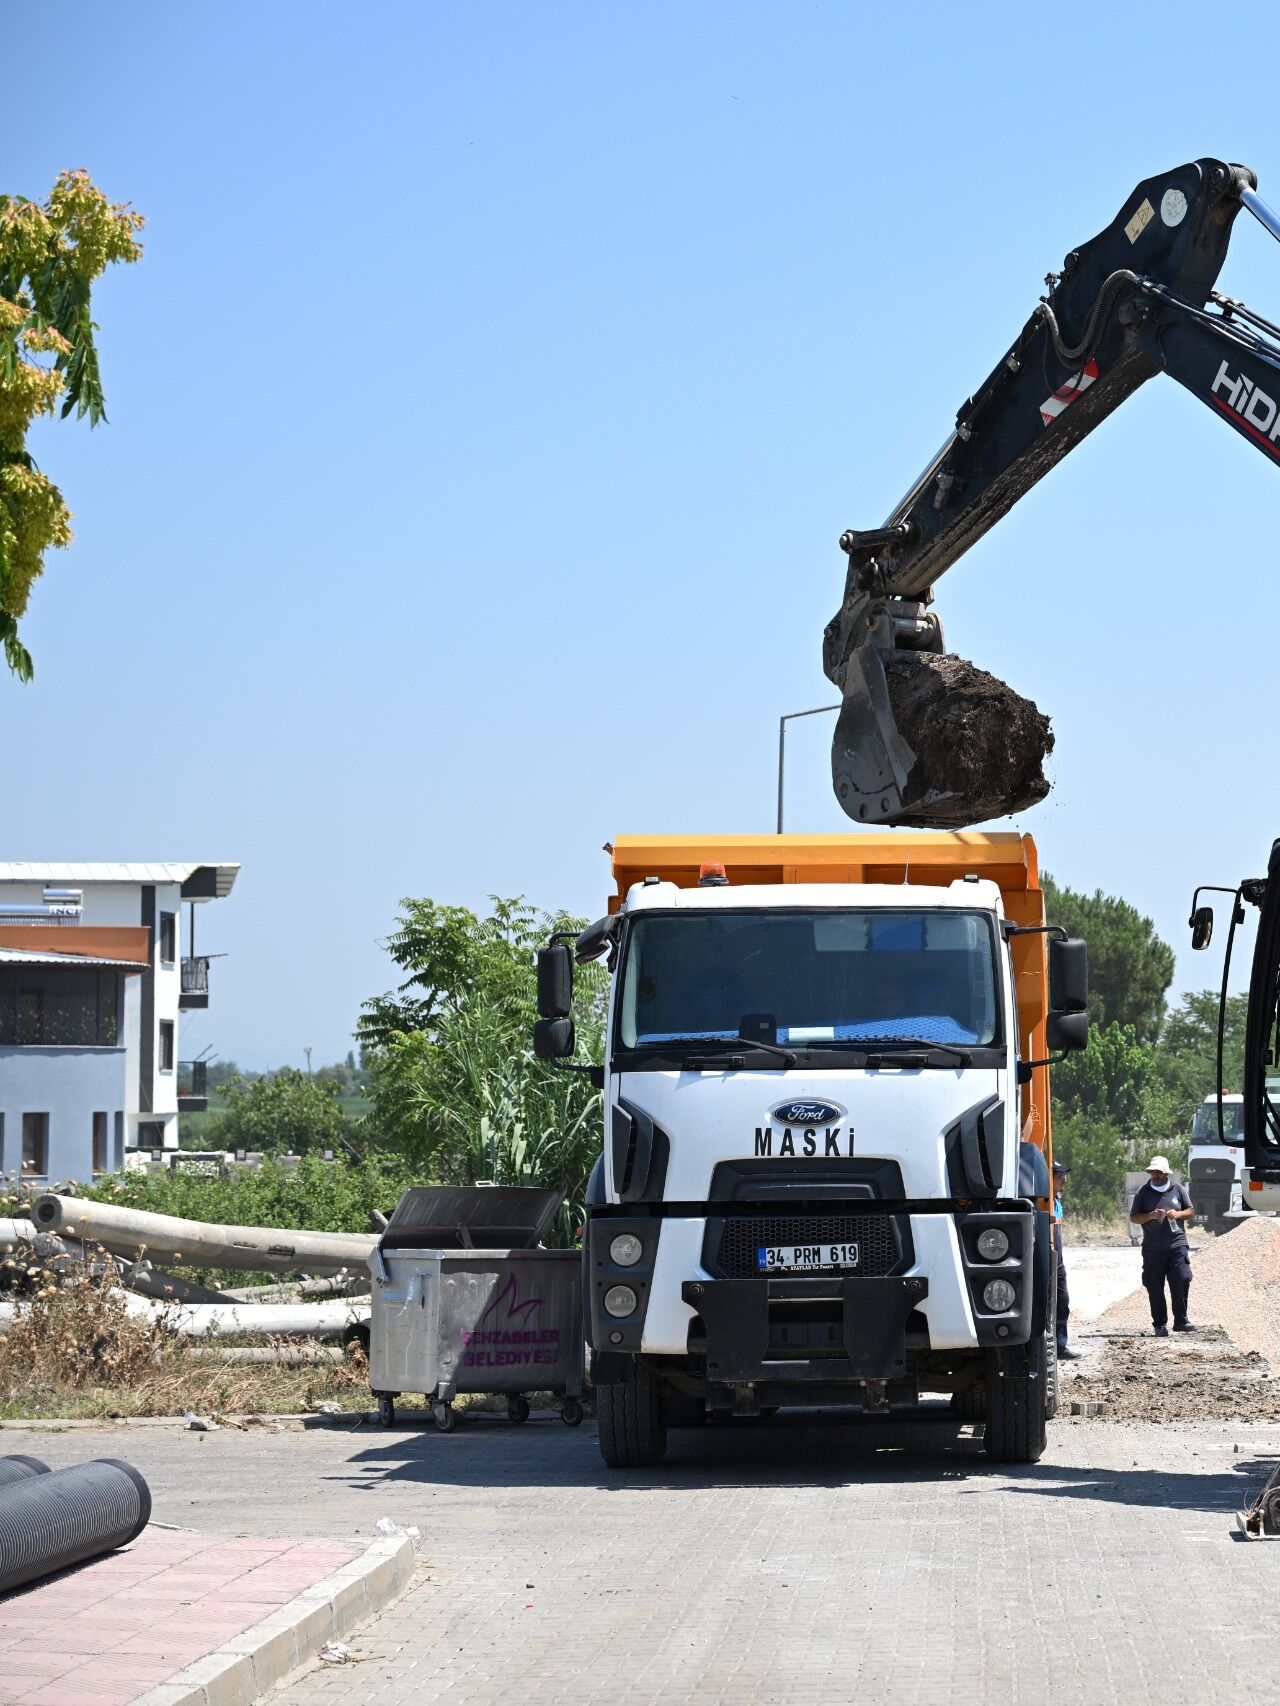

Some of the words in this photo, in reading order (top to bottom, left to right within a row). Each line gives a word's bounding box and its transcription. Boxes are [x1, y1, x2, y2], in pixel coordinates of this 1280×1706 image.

[787, 1104, 826, 1121] Ford
[766, 1249, 785, 1266] 34
[793, 1246, 821, 1265] PRM
[829, 1245, 857, 1263] 619
